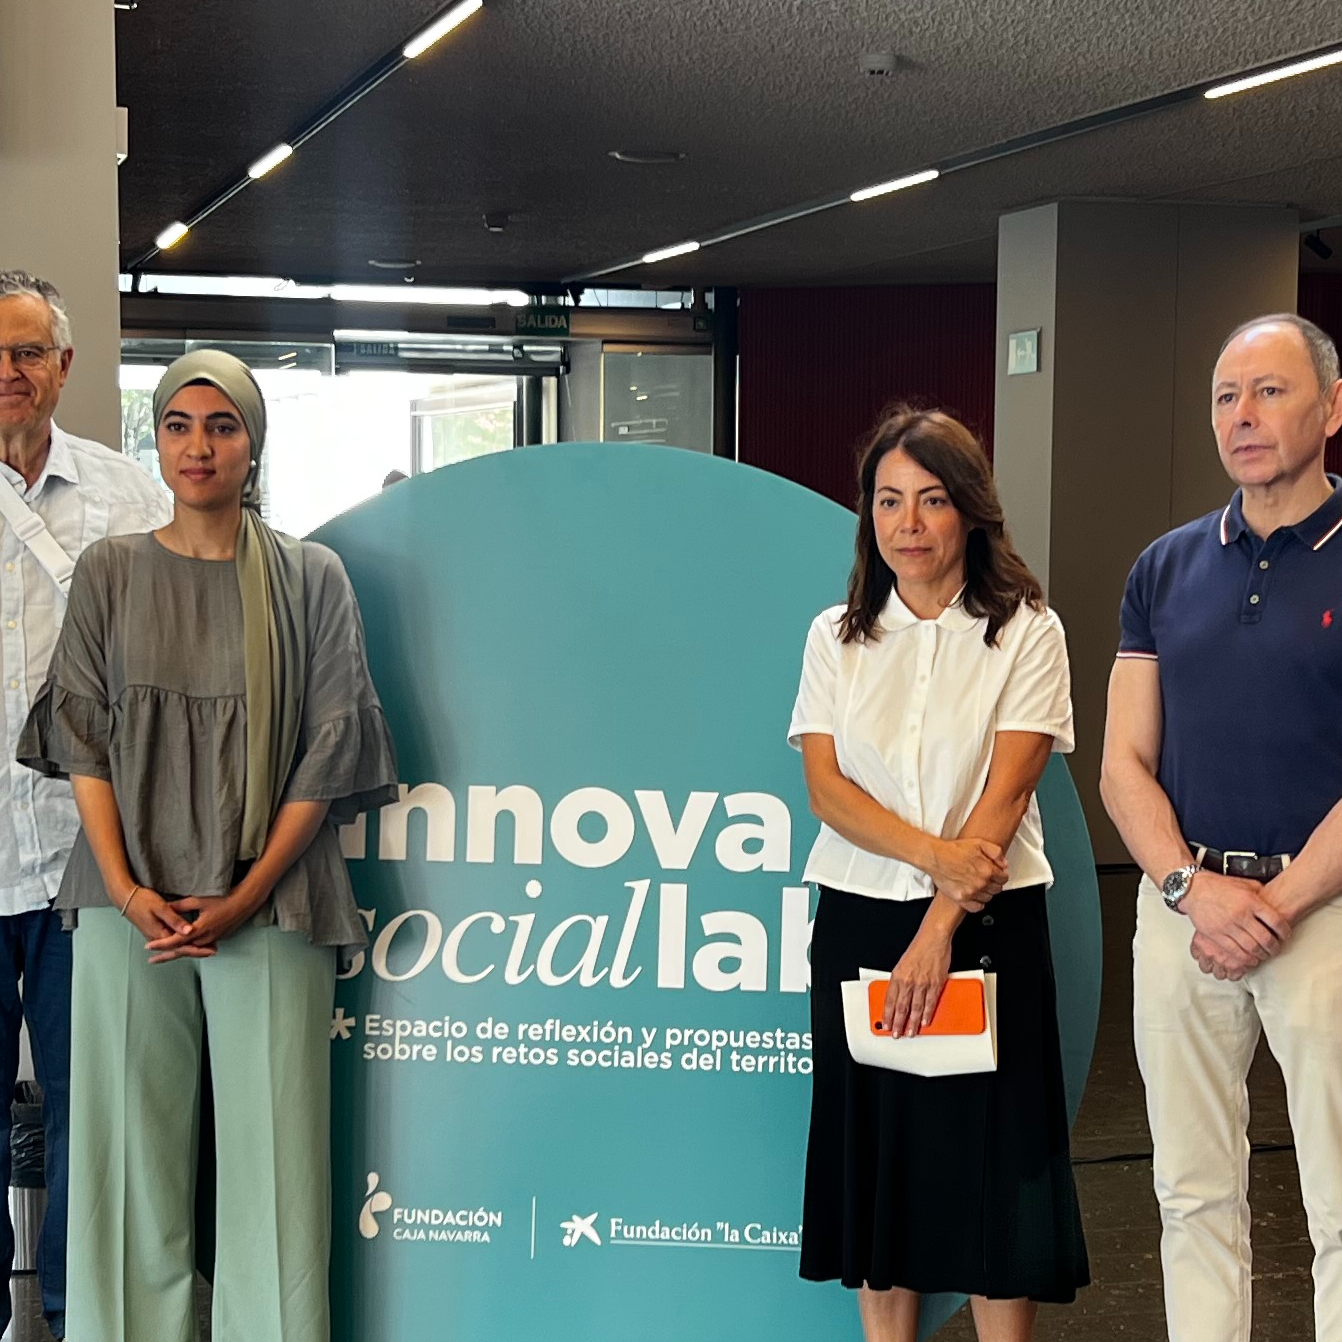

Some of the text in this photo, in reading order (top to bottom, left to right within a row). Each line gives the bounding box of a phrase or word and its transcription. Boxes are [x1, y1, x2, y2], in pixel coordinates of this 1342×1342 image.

[516, 313, 568, 329] SALIDA
[365, 1014, 813, 1051] Espacio de reflexión y propuestas
[363, 1041, 438, 1063] sobre
[446, 1039, 484, 1063] los
[491, 1043, 559, 1066] retos
[566, 1045, 673, 1070] sociales
[680, 1047, 722, 1071] del
[392, 1206, 502, 1227] FUNDACIÓN
[392, 1228, 491, 1243] CAJA NAVARRA
[609, 1217, 712, 1242] Fundación
